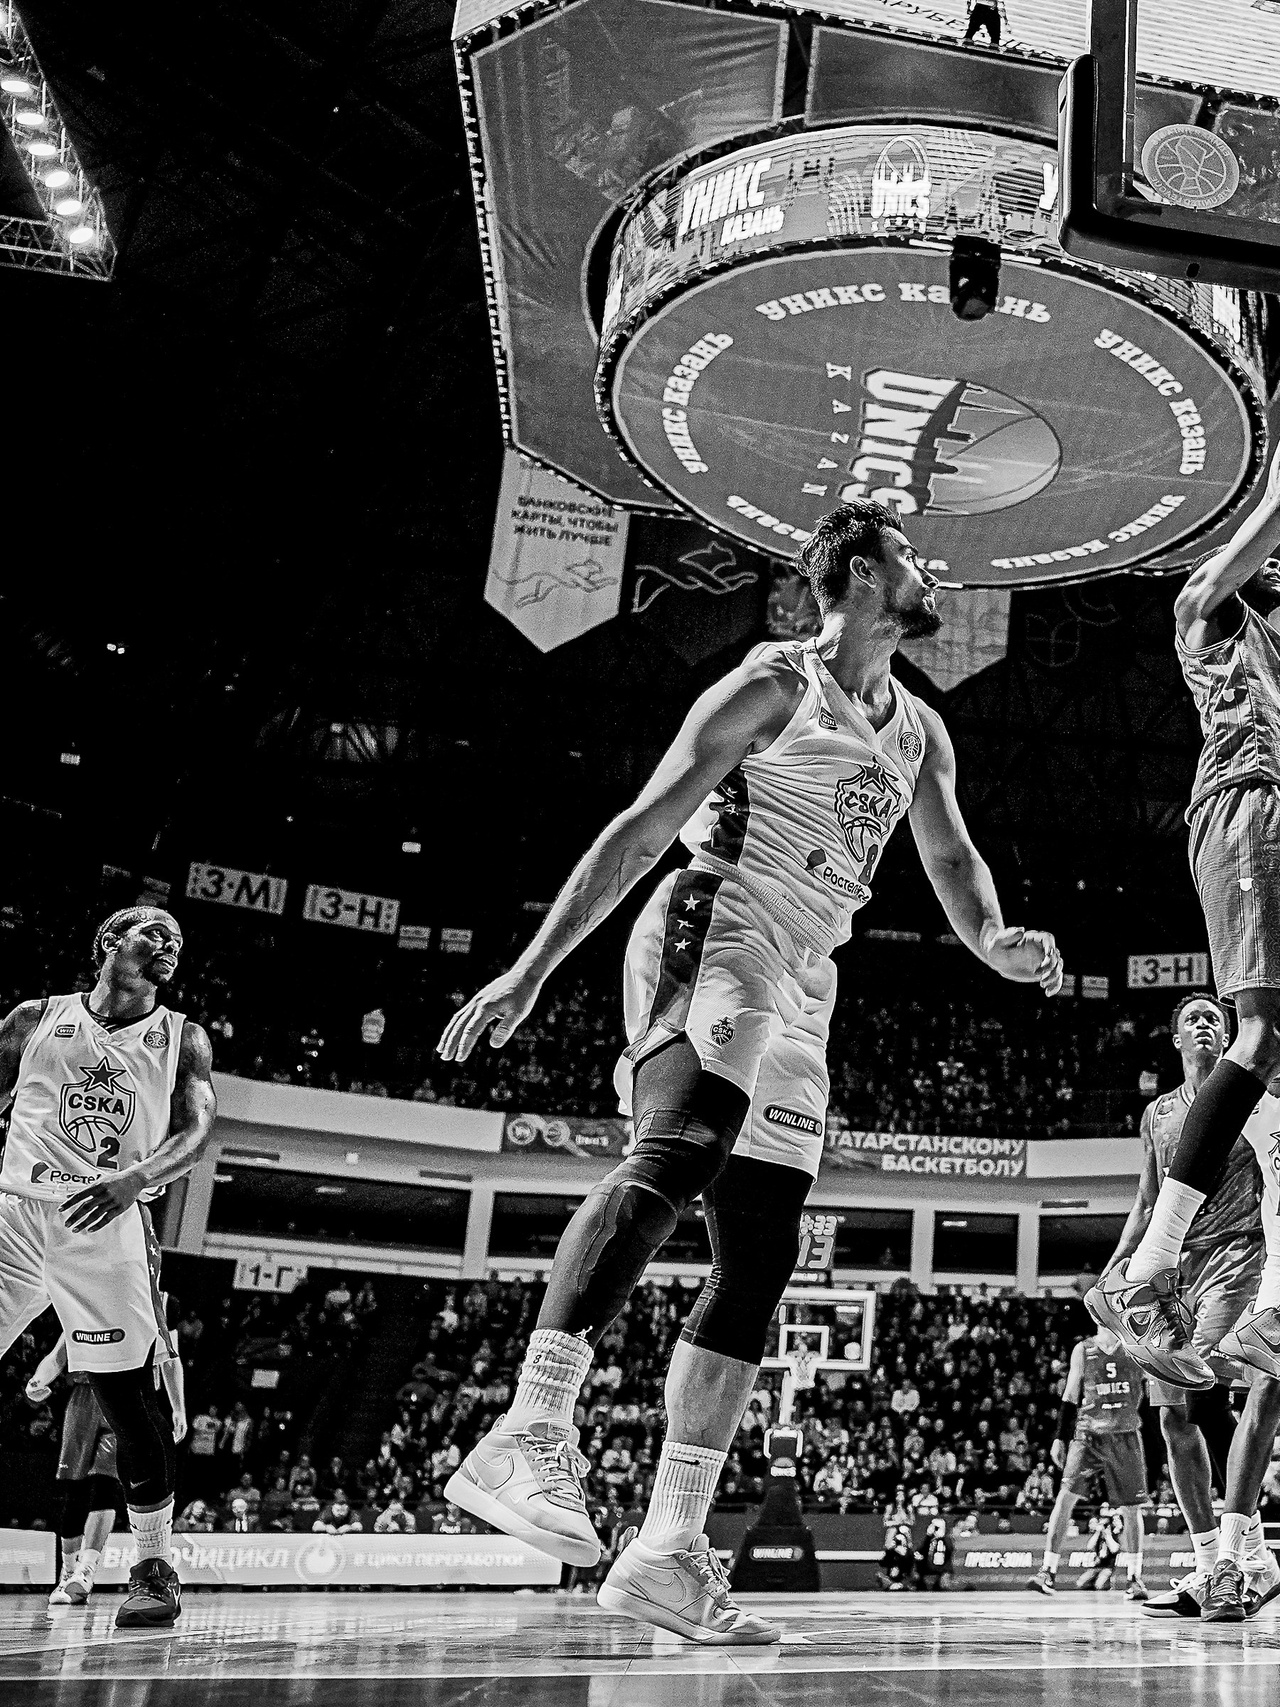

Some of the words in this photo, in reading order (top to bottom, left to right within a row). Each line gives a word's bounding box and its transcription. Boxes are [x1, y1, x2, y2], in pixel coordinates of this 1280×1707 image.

[845, 790, 893, 819] CSKA
[712, 1026, 732, 1036] CSKA
[68, 1093, 125, 1116] CSKA
[769, 1108, 815, 1131] WINLINE
[97, 1136, 120, 1170] 2
[826, 1130, 1025, 1155] ТАТАРСТАНСКОМУ
[881, 1154, 1024, 1177] БАСКЕТБОЛУ
